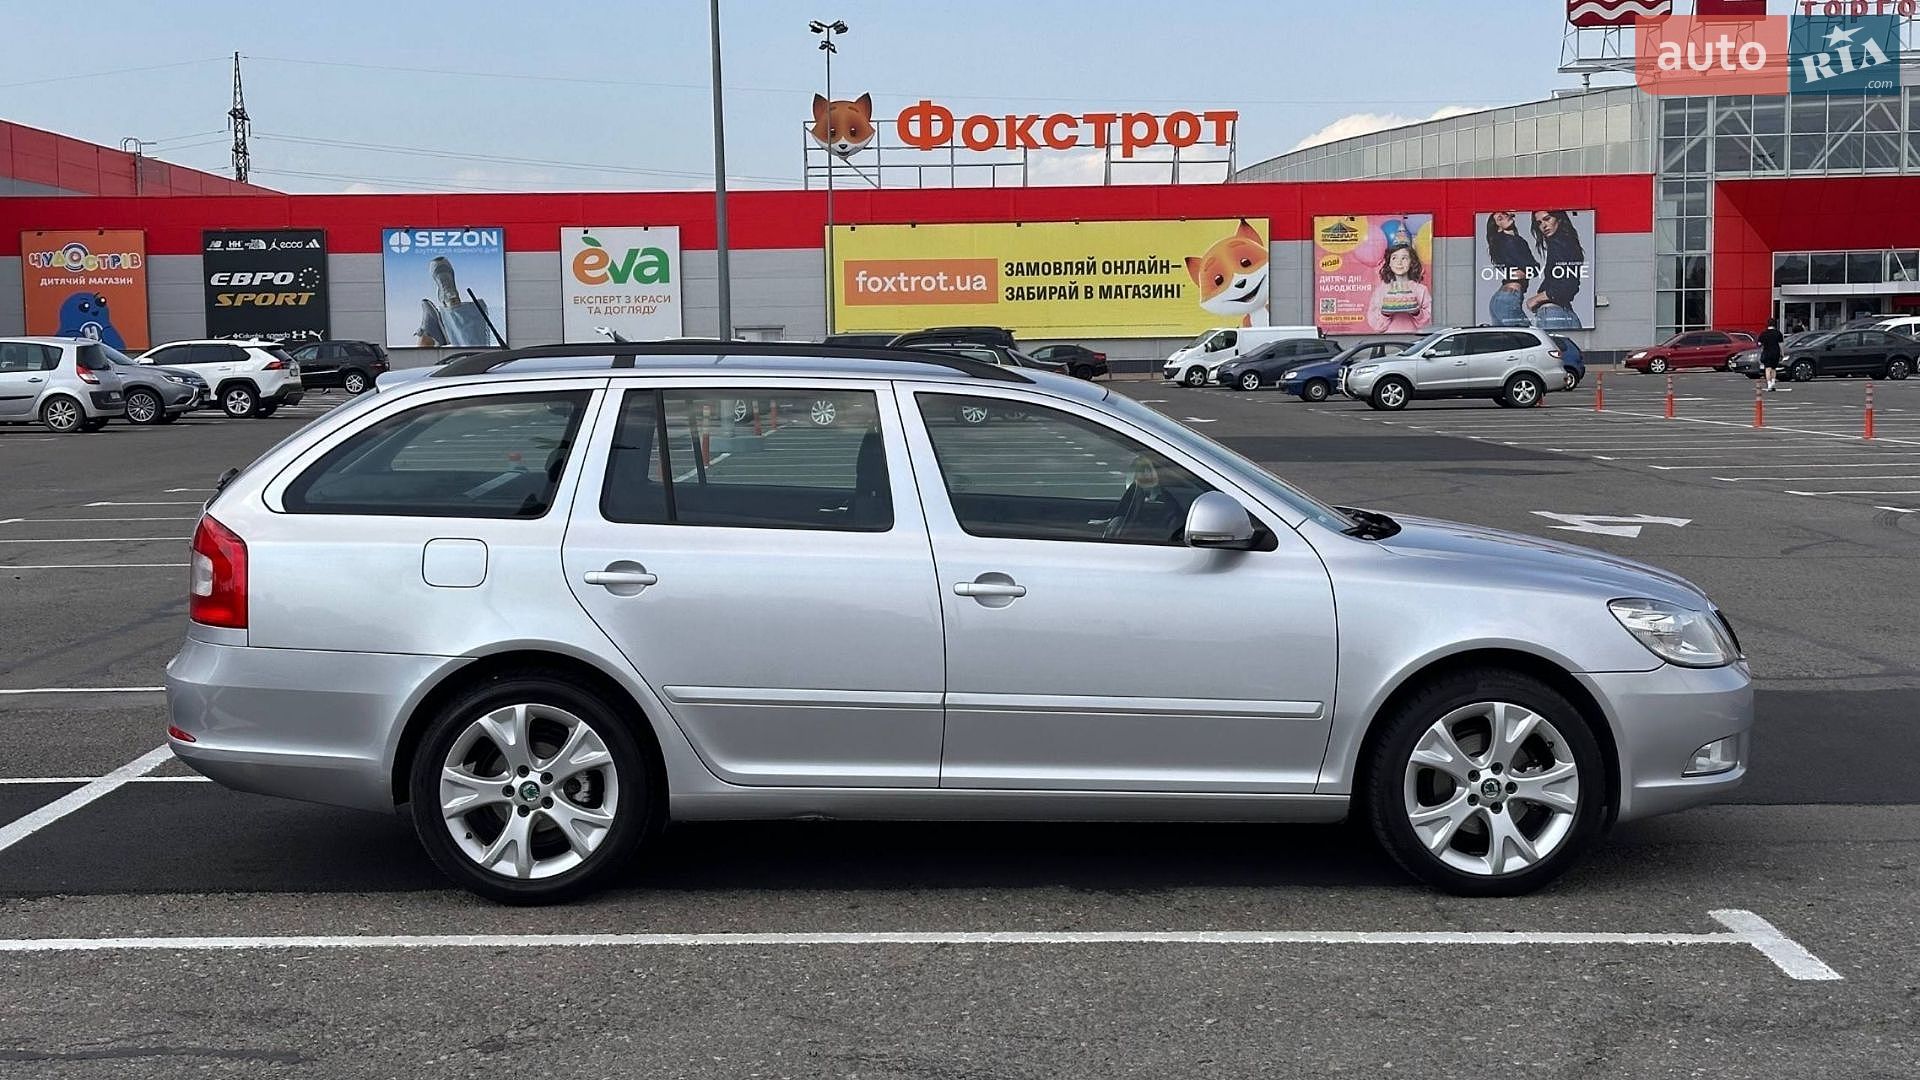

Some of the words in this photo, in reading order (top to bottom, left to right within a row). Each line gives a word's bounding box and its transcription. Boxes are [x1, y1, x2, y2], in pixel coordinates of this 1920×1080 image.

[897, 100, 1238, 158] Фокстрот
[280, 241, 303, 249] ecco
[415, 231, 498, 247] SEZON
[29, 242, 142, 272] ЧУДОСТРІВ
[1005, 256, 1097, 276] ЗАМОВЛЯЙ
[1481, 267, 1519, 280] ONE
[1525, 266, 1546, 280] BY
[1551, 265, 1590, 279] ONE
[40, 276, 86, 286] ДИТЯЧИЙ
[88, 277, 133, 285] МАГАЗИН
[856, 271, 987, 294] foxtrot.ua
[1005, 281, 1079, 300] ЗАБИРАЙ
[1084, 285, 1094, 300] В
[215, 292, 316, 306] SPORT
[574, 296, 621, 304] ЕКСПЕРТ
[625, 296, 632, 304] З
[635, 295, 671, 304] КРАСИ
[587, 306, 601, 314] ТА
[605, 305, 657, 316] ДОГЛЯДУ
